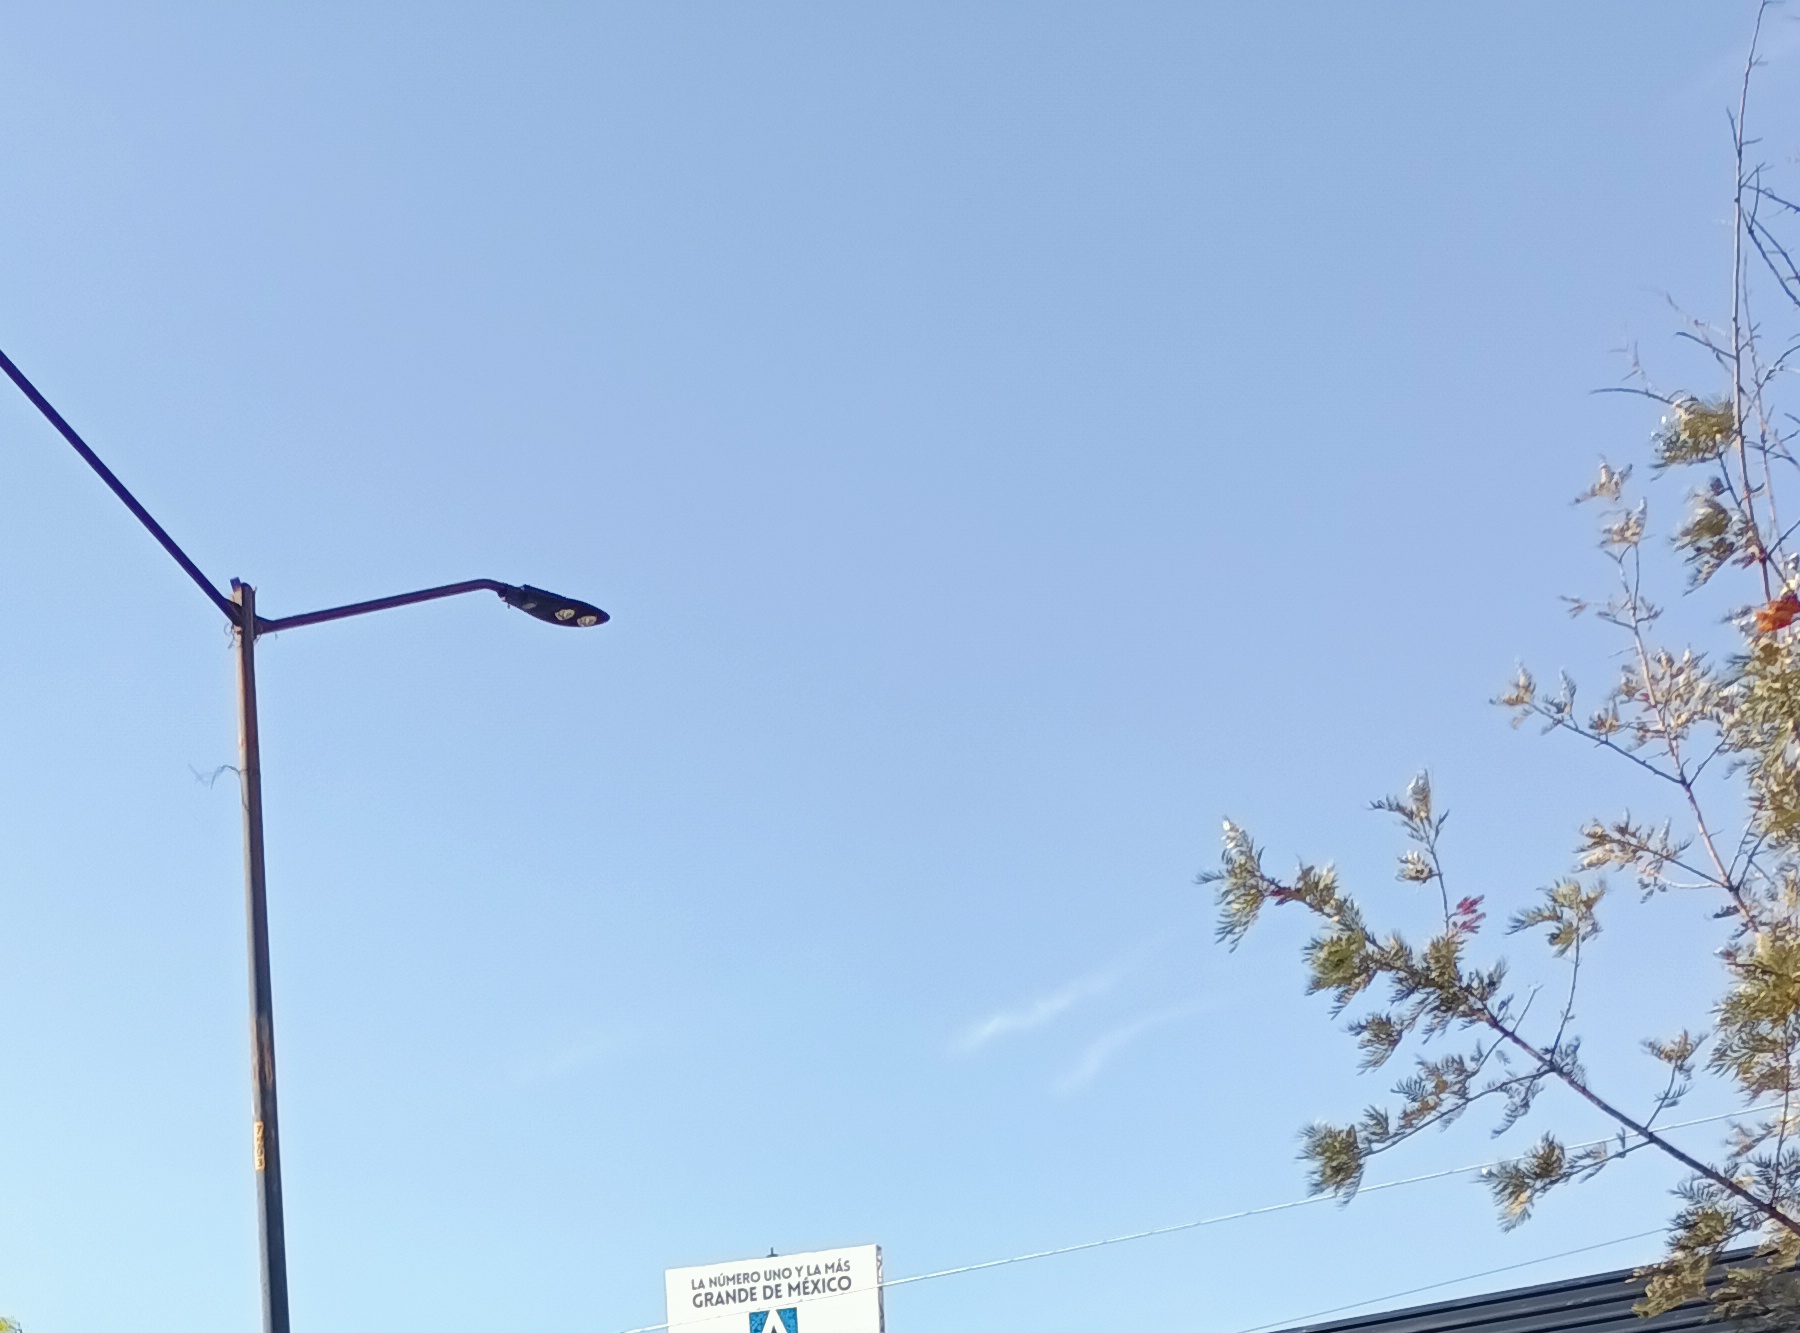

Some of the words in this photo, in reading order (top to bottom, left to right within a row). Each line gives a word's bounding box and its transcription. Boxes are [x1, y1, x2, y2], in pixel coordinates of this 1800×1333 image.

[691, 1278, 705, 1290] LA
[708, 1271, 761, 1288] NÚMERO
[764, 1267, 792, 1281] UNO
[795, 1266, 803, 1278] Y
[806, 1264, 821, 1276] LA
[824, 1258, 850, 1274] MÁS
[692, 1286, 757, 1308] GRANDE
[763, 1283, 782, 1300] DE
[788, 1275, 852, 1297] MÉXICO
